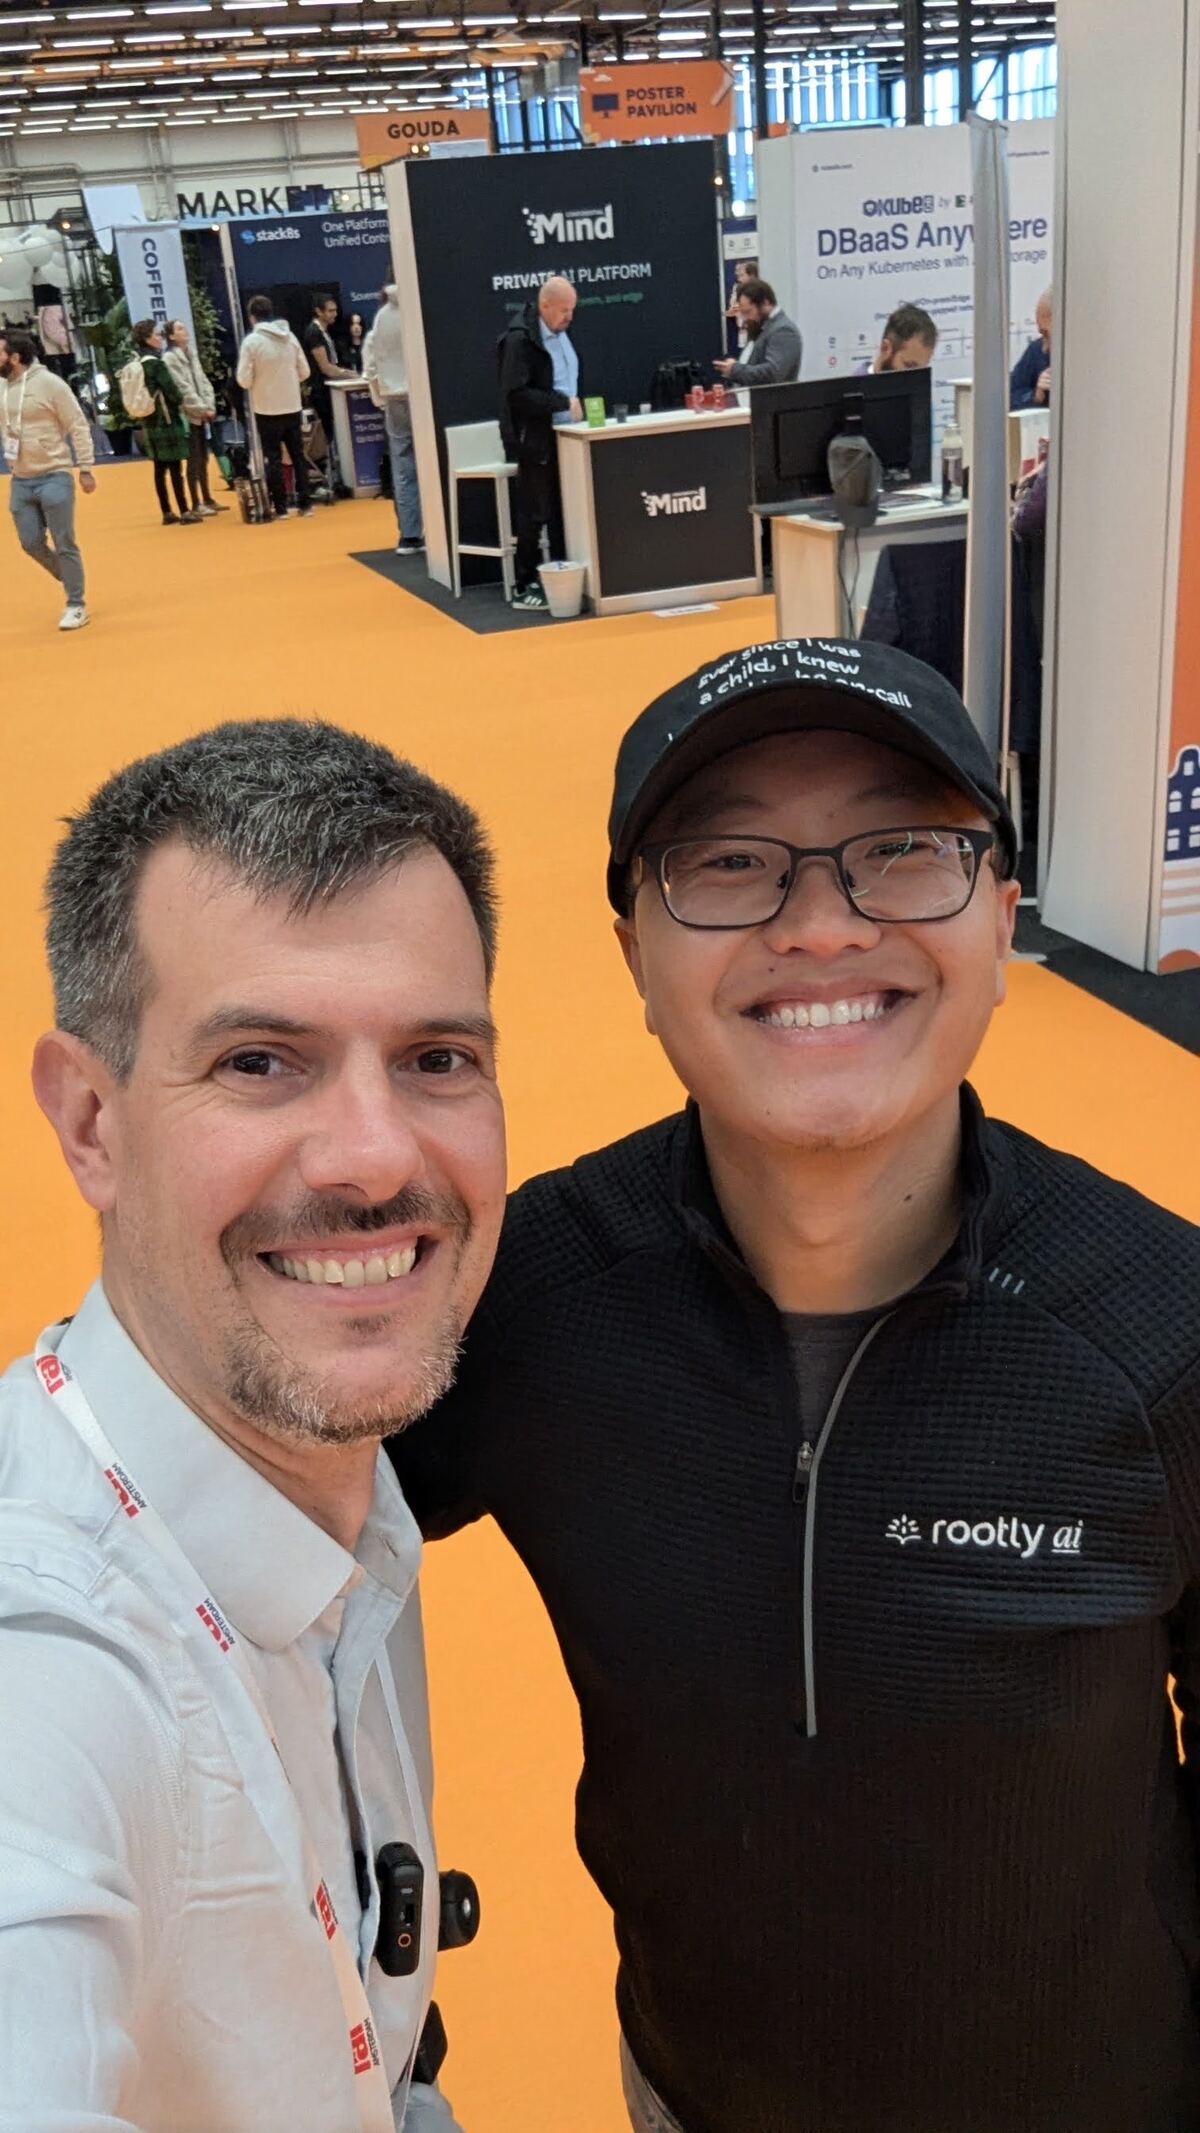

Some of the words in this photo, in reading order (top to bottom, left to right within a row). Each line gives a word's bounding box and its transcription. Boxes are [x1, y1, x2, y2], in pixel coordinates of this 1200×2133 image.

[625, 86, 685, 101] POSTER
[626, 102, 697, 118] PAVILION
[387, 119, 460, 140] GOUDA
[256, 227, 301, 242] stack8s
[322, 221, 344, 233] One
[530, 203, 615, 245] Mind
[324, 232, 361, 248] Unified
[817, 222, 909, 257] DBaaS
[577, 263, 653, 283] PLATFORM
[817, 265, 837, 280] On
[839, 263, 865, 280] Any
[868, 258, 941, 276] Kubernetes
[944, 255, 970, 270] with
[141, 237, 169, 324] COFFEE
[645, 486, 707, 517] Mind
[741, 639, 800, 661] since
[817, 640, 862, 658] was
[699, 692, 713, 706] a
[717, 657, 777, 695] child,
[782, 653, 789, 666] I
[797, 650, 860, 675] knew
[112, 1462, 148, 1510] AMSTERDAM
[931, 1515, 1046, 1559] rootly
[1051, 1519, 1084, 1552] ai
[203, 1597, 236, 1646] AMSTERDAM
